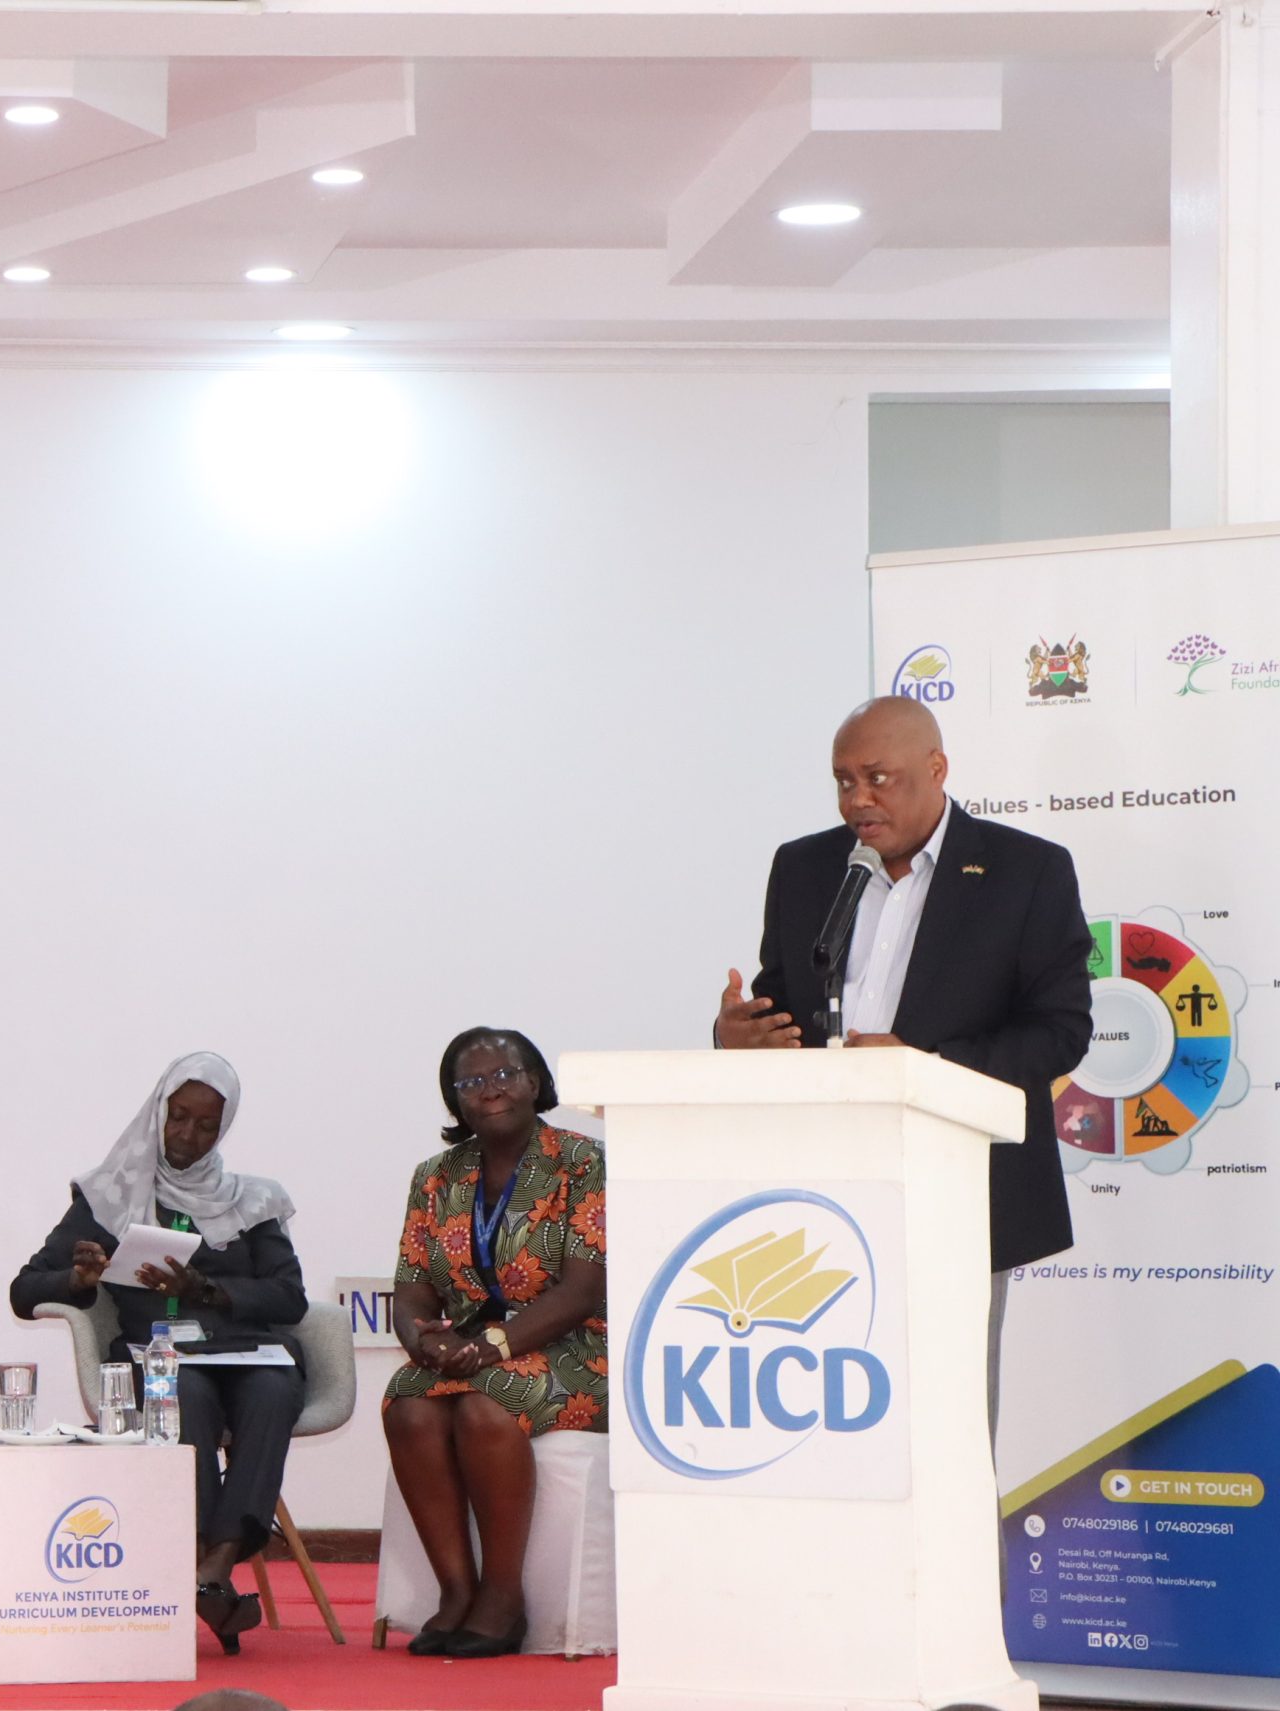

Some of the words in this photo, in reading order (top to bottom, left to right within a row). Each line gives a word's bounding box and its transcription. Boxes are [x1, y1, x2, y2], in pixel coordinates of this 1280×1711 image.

[1231, 661, 1254, 675] Zizi
[900, 681, 955, 704] KICD
[1050, 792, 1114, 811] based
[1121, 786, 1236, 808] Education
[1203, 910, 1229, 919] Love
[1091, 1032, 1130, 1041] VALUES
[1207, 1163, 1267, 1176] patriotism
[1091, 1183, 1121, 1196] Unity
[1031, 1263, 1088, 1279] values
[1094, 1264, 1107, 1279] is
[1113, 1266, 1142, 1282] my
[1147, 1263, 1274, 1283] responsibility
[663, 1345, 891, 1433] KICD
[1139, 1480, 1170, 1493] GET
[1175, 1482, 1191, 1494] IN
[1195, 1482, 1253, 1496] TOUCH
[1062, 1517, 1138, 1532] 0748029186
[1155, 1520, 1234, 1535] 0748029681
[56, 1542, 124, 1569] KICD
[1058, 1548, 1081, 1557] Desai
[1099, 1549, 1112, 1558] Off
[1114, 1551, 1153, 1562] Muranga
[1077, 1573, 1093, 1582] Box
[15, 1591, 58, 1602] KENYA
[62, 1590, 129, 1602] INSTITUTE
[132, 1589, 150, 1600] OF
[81, 1605, 179, 1618] DEVELOPMENT
[0, 1625, 48, 1636] Nurturing
[50, 1624, 77, 1634] Every
[128, 1621, 170, 1632] Potential
